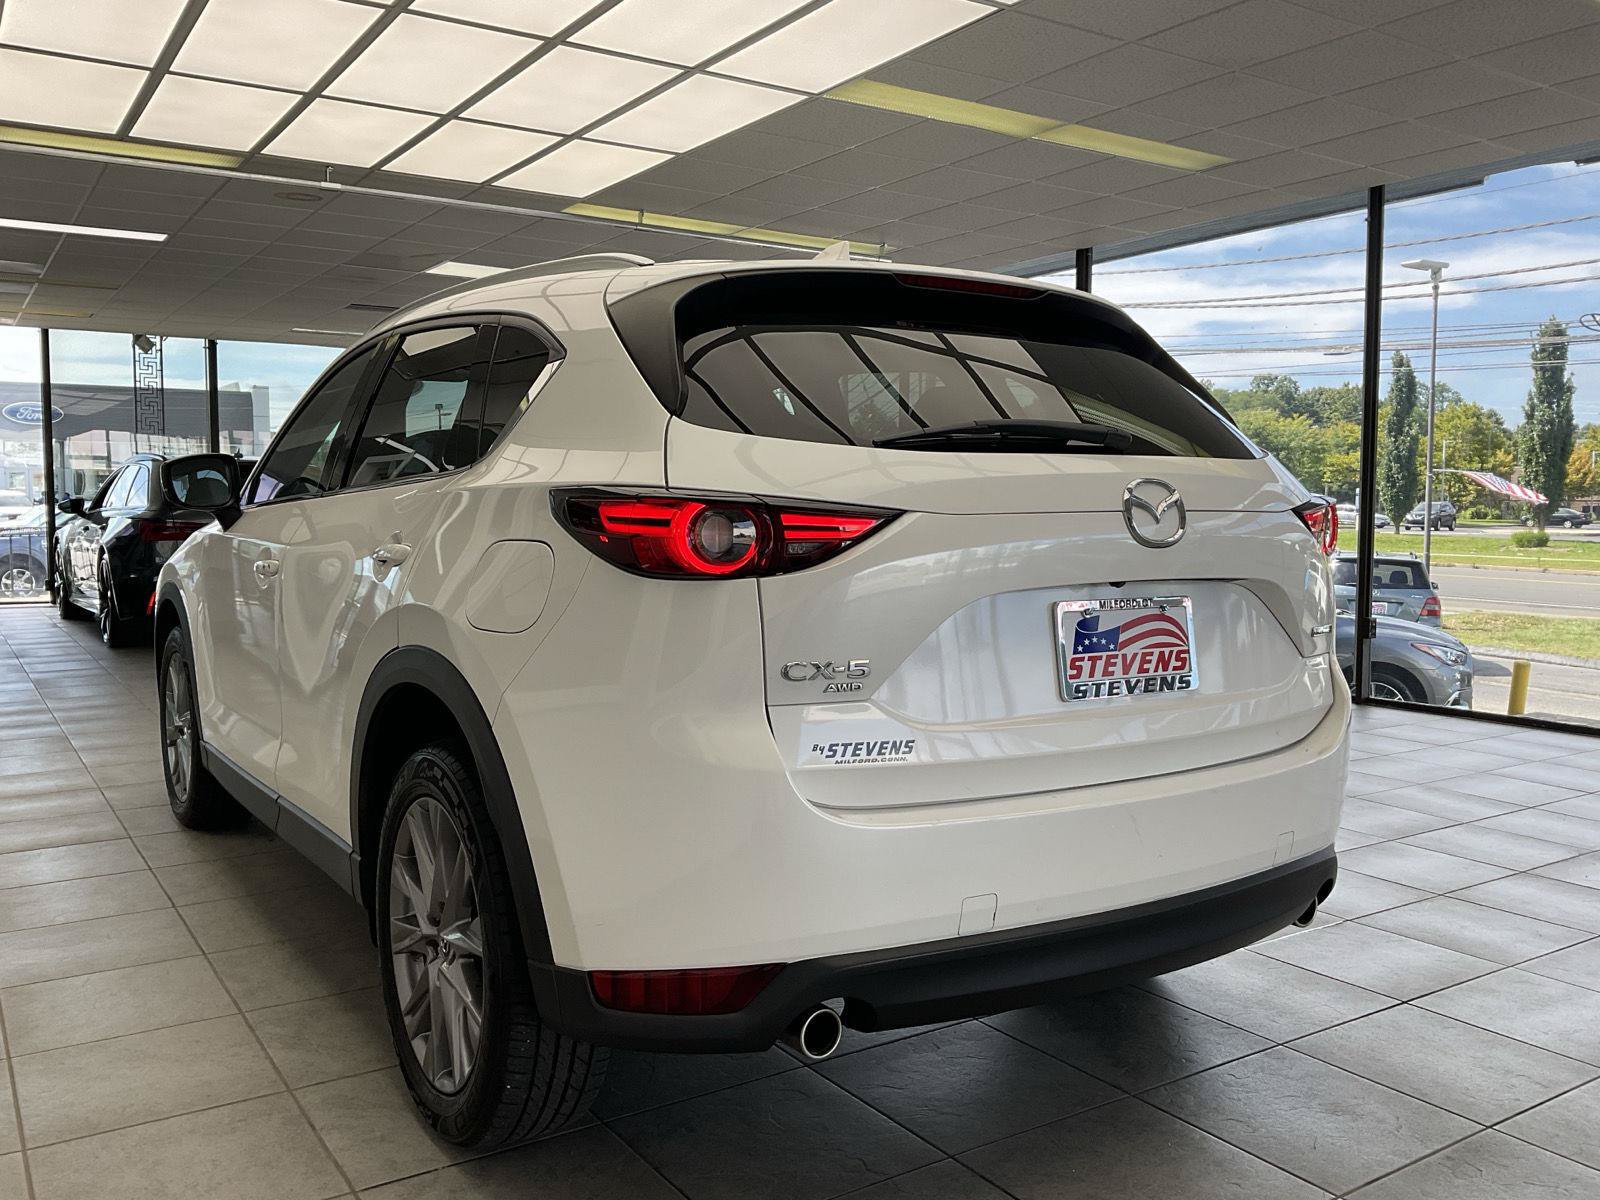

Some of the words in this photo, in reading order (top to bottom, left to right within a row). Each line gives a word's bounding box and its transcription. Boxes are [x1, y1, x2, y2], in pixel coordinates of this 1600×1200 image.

[780, 659, 871, 682] CX-5
[1068, 649, 1189, 681] STEVENS
[823, 682, 864, 694] AWD
[1072, 674, 1192, 700] STEVENS
[825, 739, 916, 759] STEVENS
